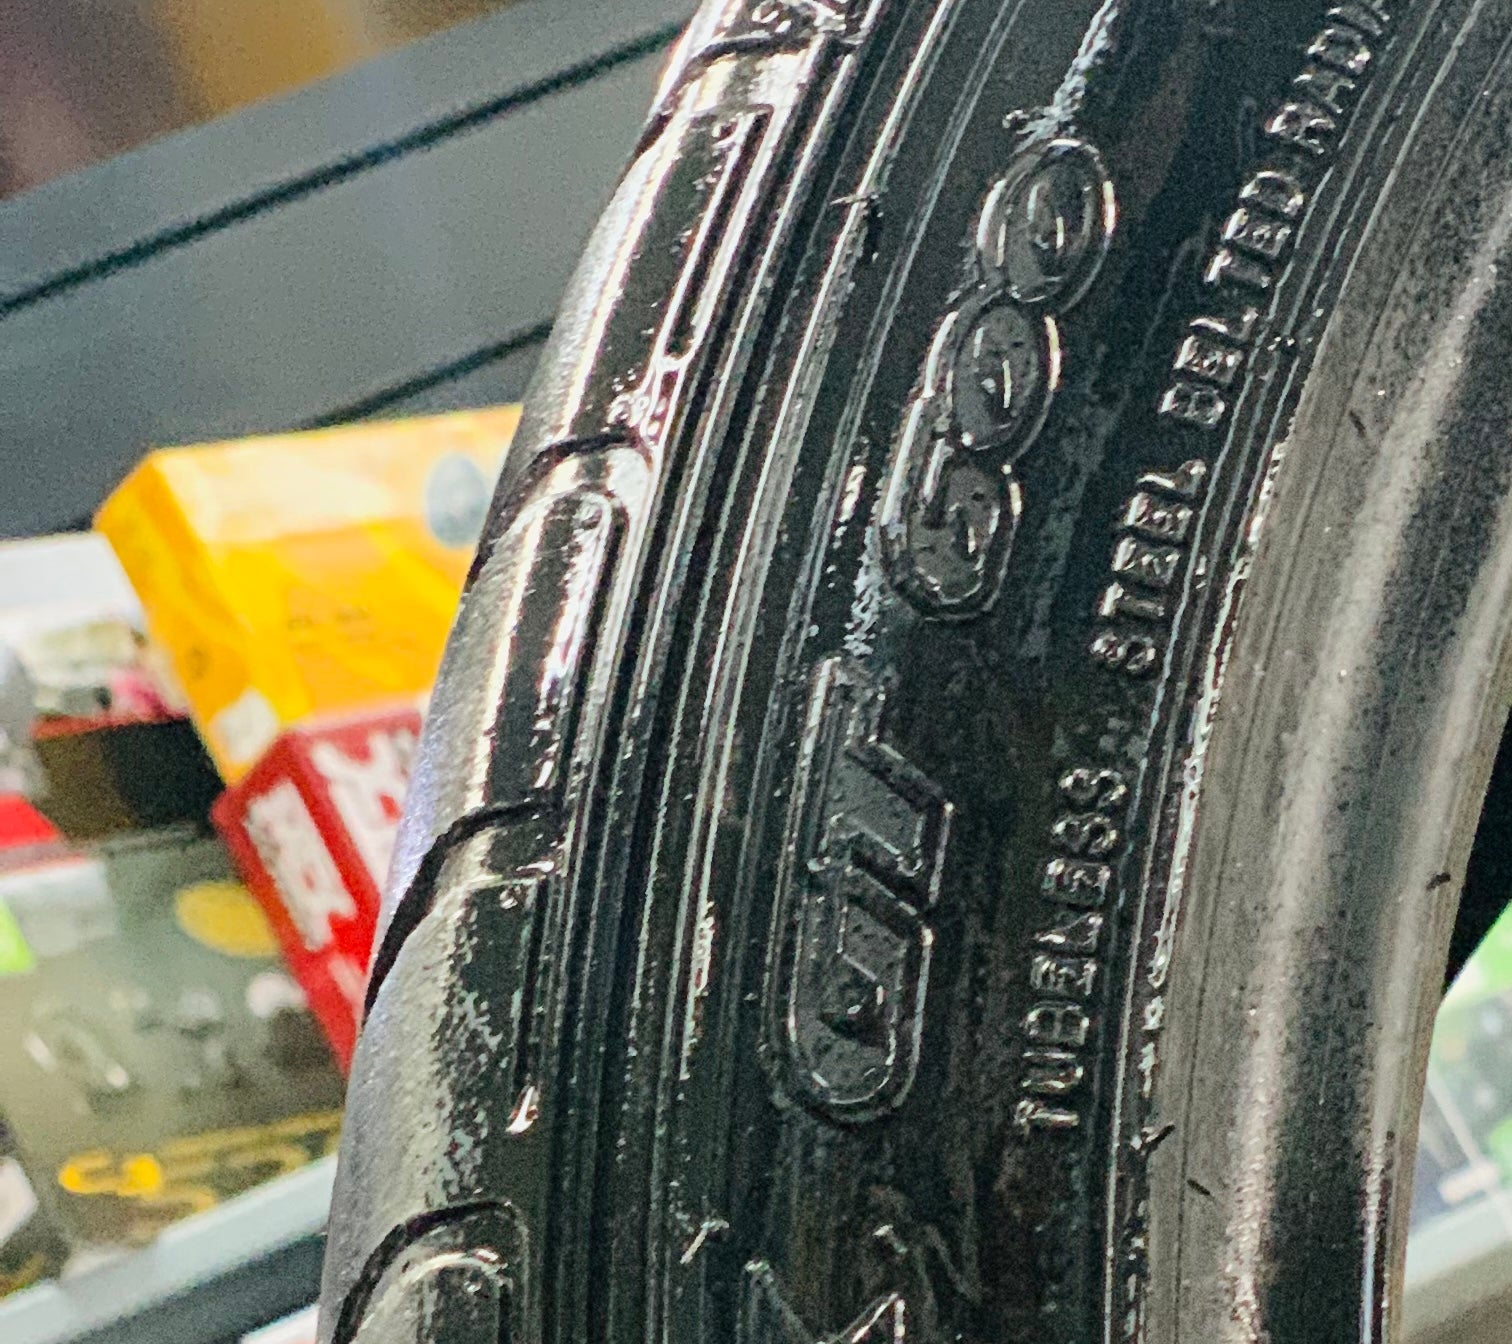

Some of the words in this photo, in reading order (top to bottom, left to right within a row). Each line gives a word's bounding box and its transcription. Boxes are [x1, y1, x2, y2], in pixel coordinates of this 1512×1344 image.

[768, 656, 953, 1126] GT
[880, 137, 1117, 621] 600
[1012, 767, 1127, 1130] TUBELESS
[1090, 459, 1206, 676] STEEL
[1156, 169, 1305, 430] BELTED
[1263, 0, 1395, 154] RADI
